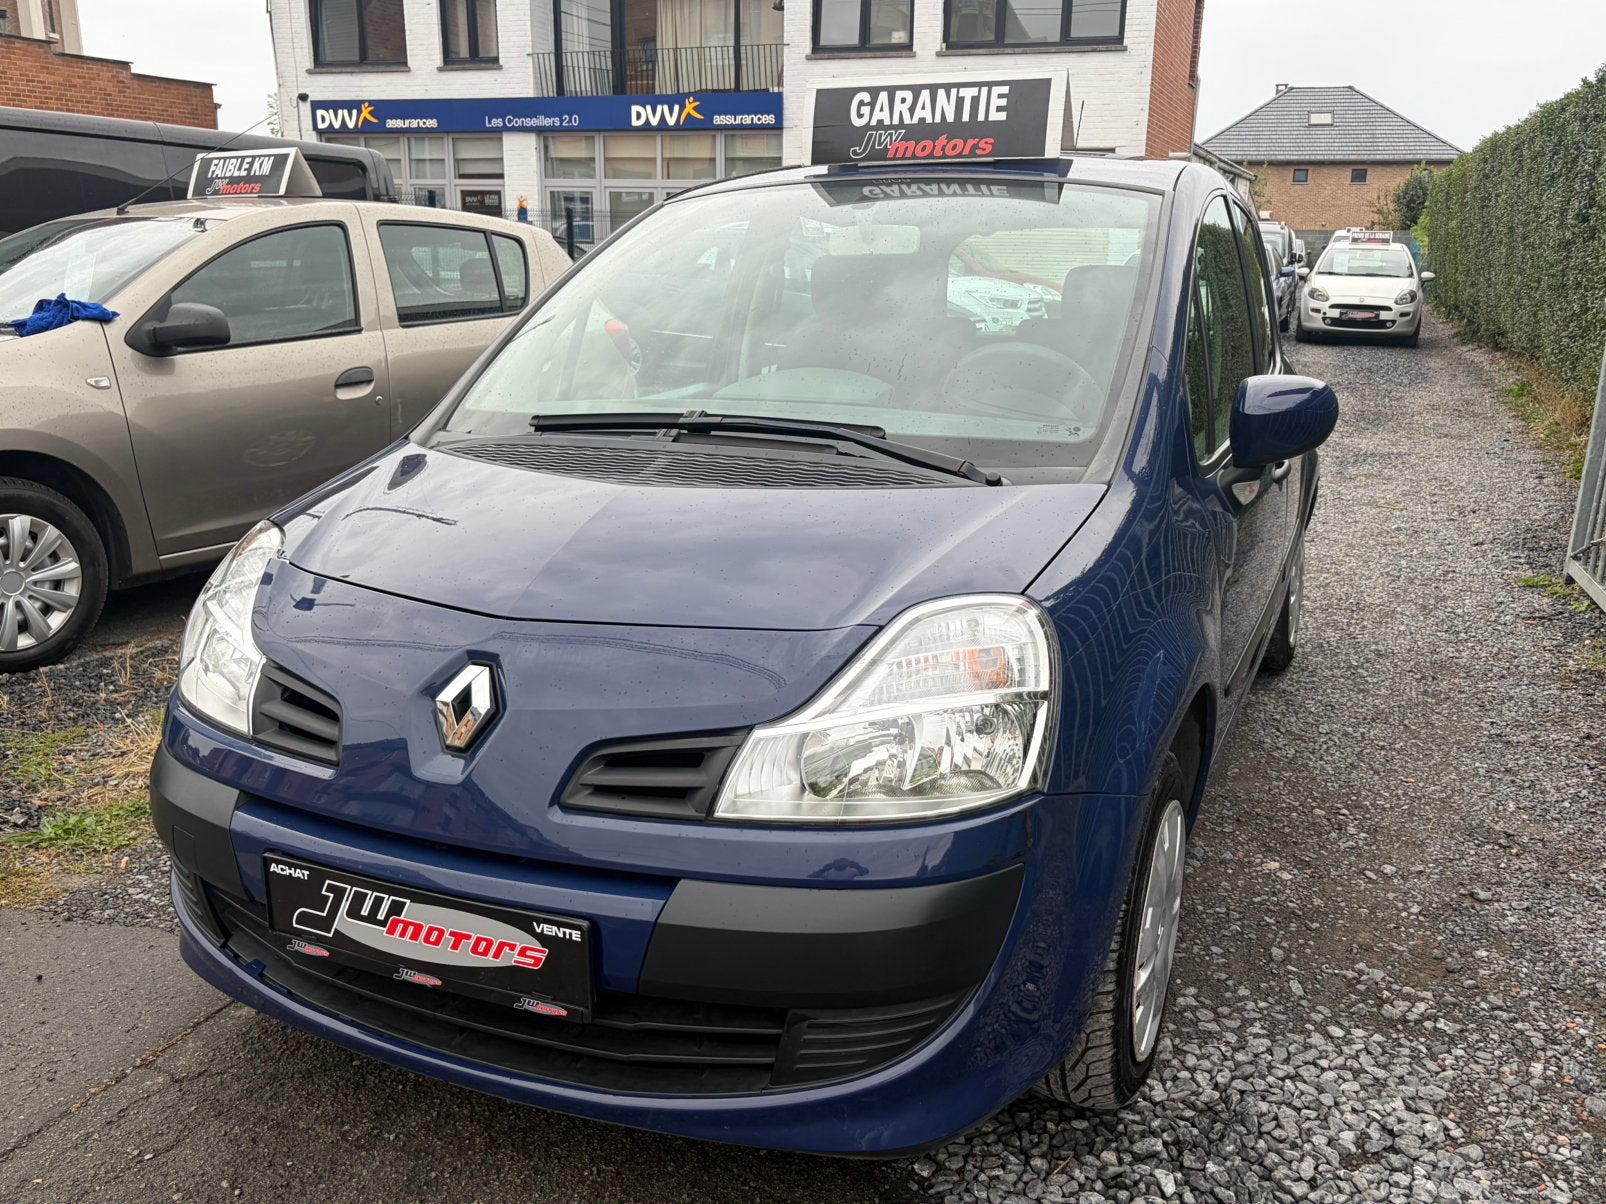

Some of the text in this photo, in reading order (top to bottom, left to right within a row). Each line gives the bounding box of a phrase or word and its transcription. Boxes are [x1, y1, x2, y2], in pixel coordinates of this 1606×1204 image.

[631, 104, 776, 126] DVV assurances
[850, 85, 1010, 127] GARANTIE
[316, 108, 438, 129] DVV assurances
[485, 114, 579, 127] Les Conseillers 2.0
[850, 129, 995, 159] JW motors
[207, 156, 275, 178] FAIBLE KM
[219, 181, 262, 195] motors
[269, 863, 310, 880] ACHAT
[293, 880, 411, 937] JW
[532, 921, 582, 941] VENTE
